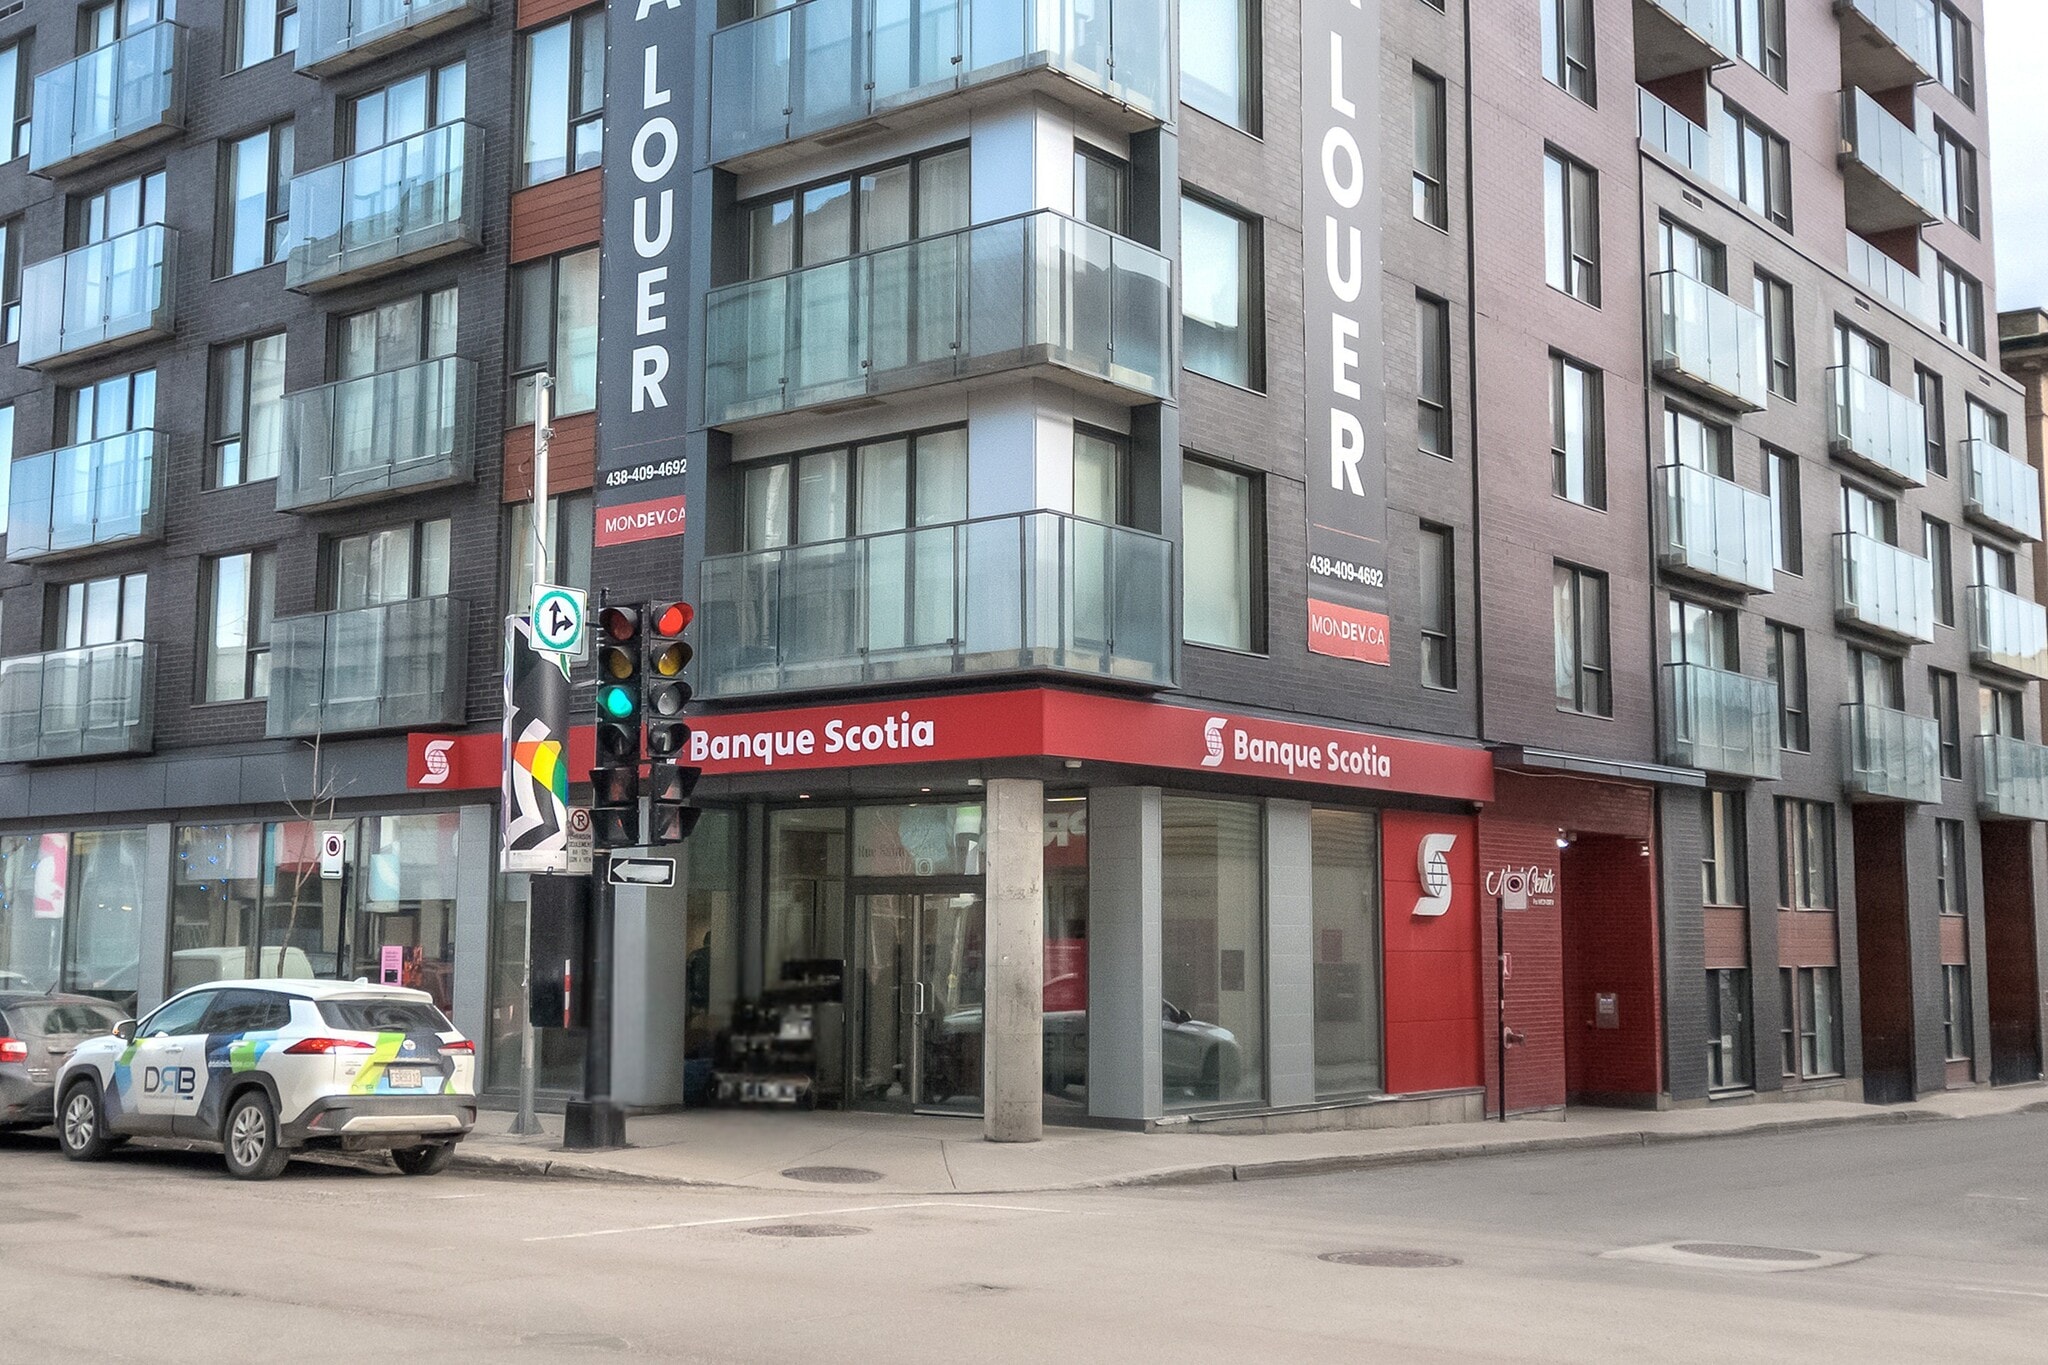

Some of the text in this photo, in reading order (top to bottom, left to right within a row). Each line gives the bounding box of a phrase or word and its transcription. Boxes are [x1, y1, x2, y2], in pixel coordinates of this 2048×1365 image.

[631, 45, 678, 413] LOUER
[1321, 31, 1365, 497] LOUER
[606, 459, 687, 487] 438-409-4692
[605, 507, 686, 533] MONDEV.CA
[1310, 555, 1384, 588] 438-409-4692
[1311, 614, 1385, 646] MONDEV.CA
[690, 711, 934, 766] Banque Scotia
[1234, 729, 1391, 777] Banque Scotia
